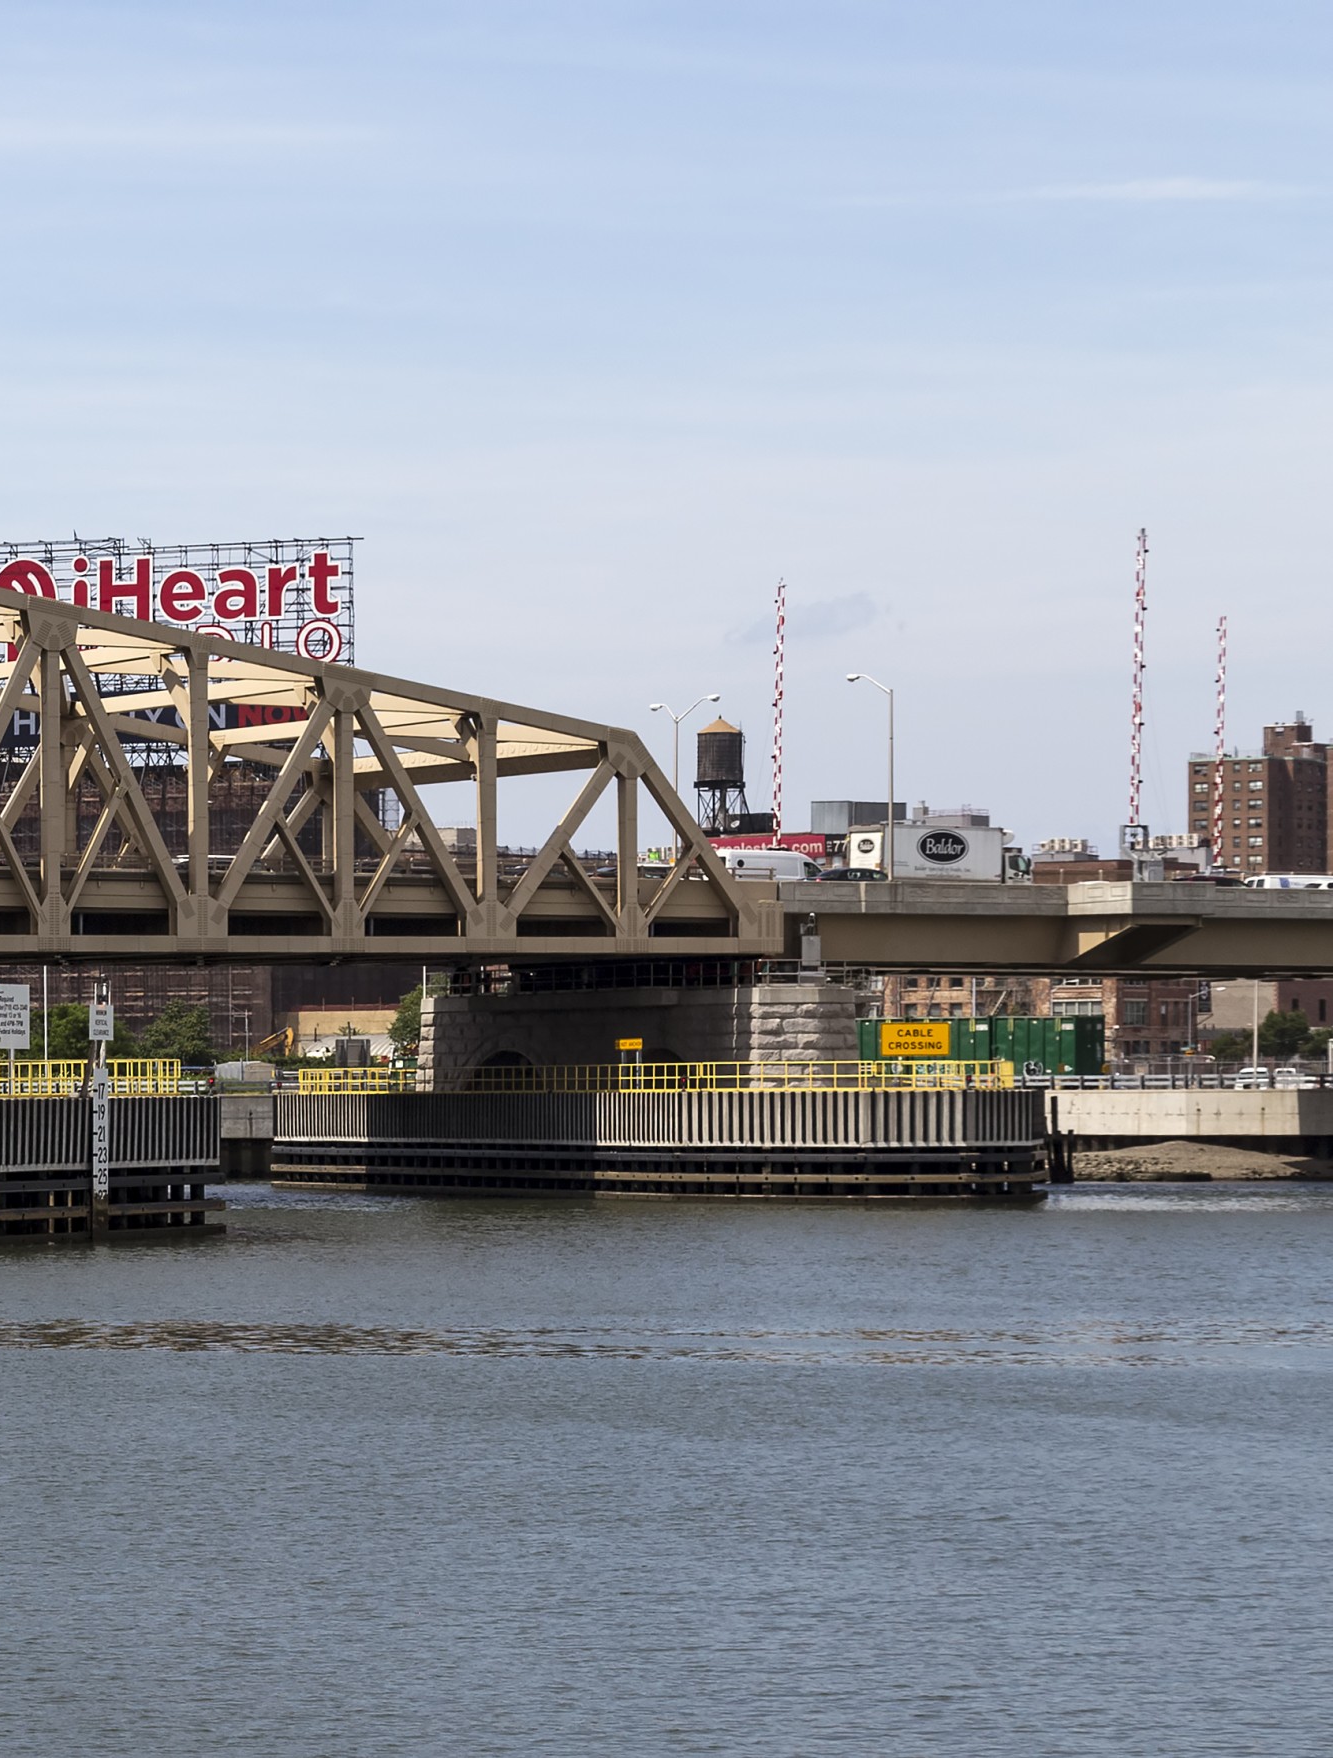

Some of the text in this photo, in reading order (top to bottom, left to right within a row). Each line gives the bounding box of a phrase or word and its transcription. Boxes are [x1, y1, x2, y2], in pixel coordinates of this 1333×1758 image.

[71, 549, 342, 622] iHeart
[925, 838, 964, 855] Baldor
[897, 1029, 934, 1038] CABLE
[888, 1041, 943, 1050] CROSSING
[97, 1083, 105, 1100] 17
[98, 1104, 105, 1121] 19
[98, 1125, 105, 1142] 21
[98, 1147, 108, 1163] 23
[98, 1168, 108, 1185] 25
